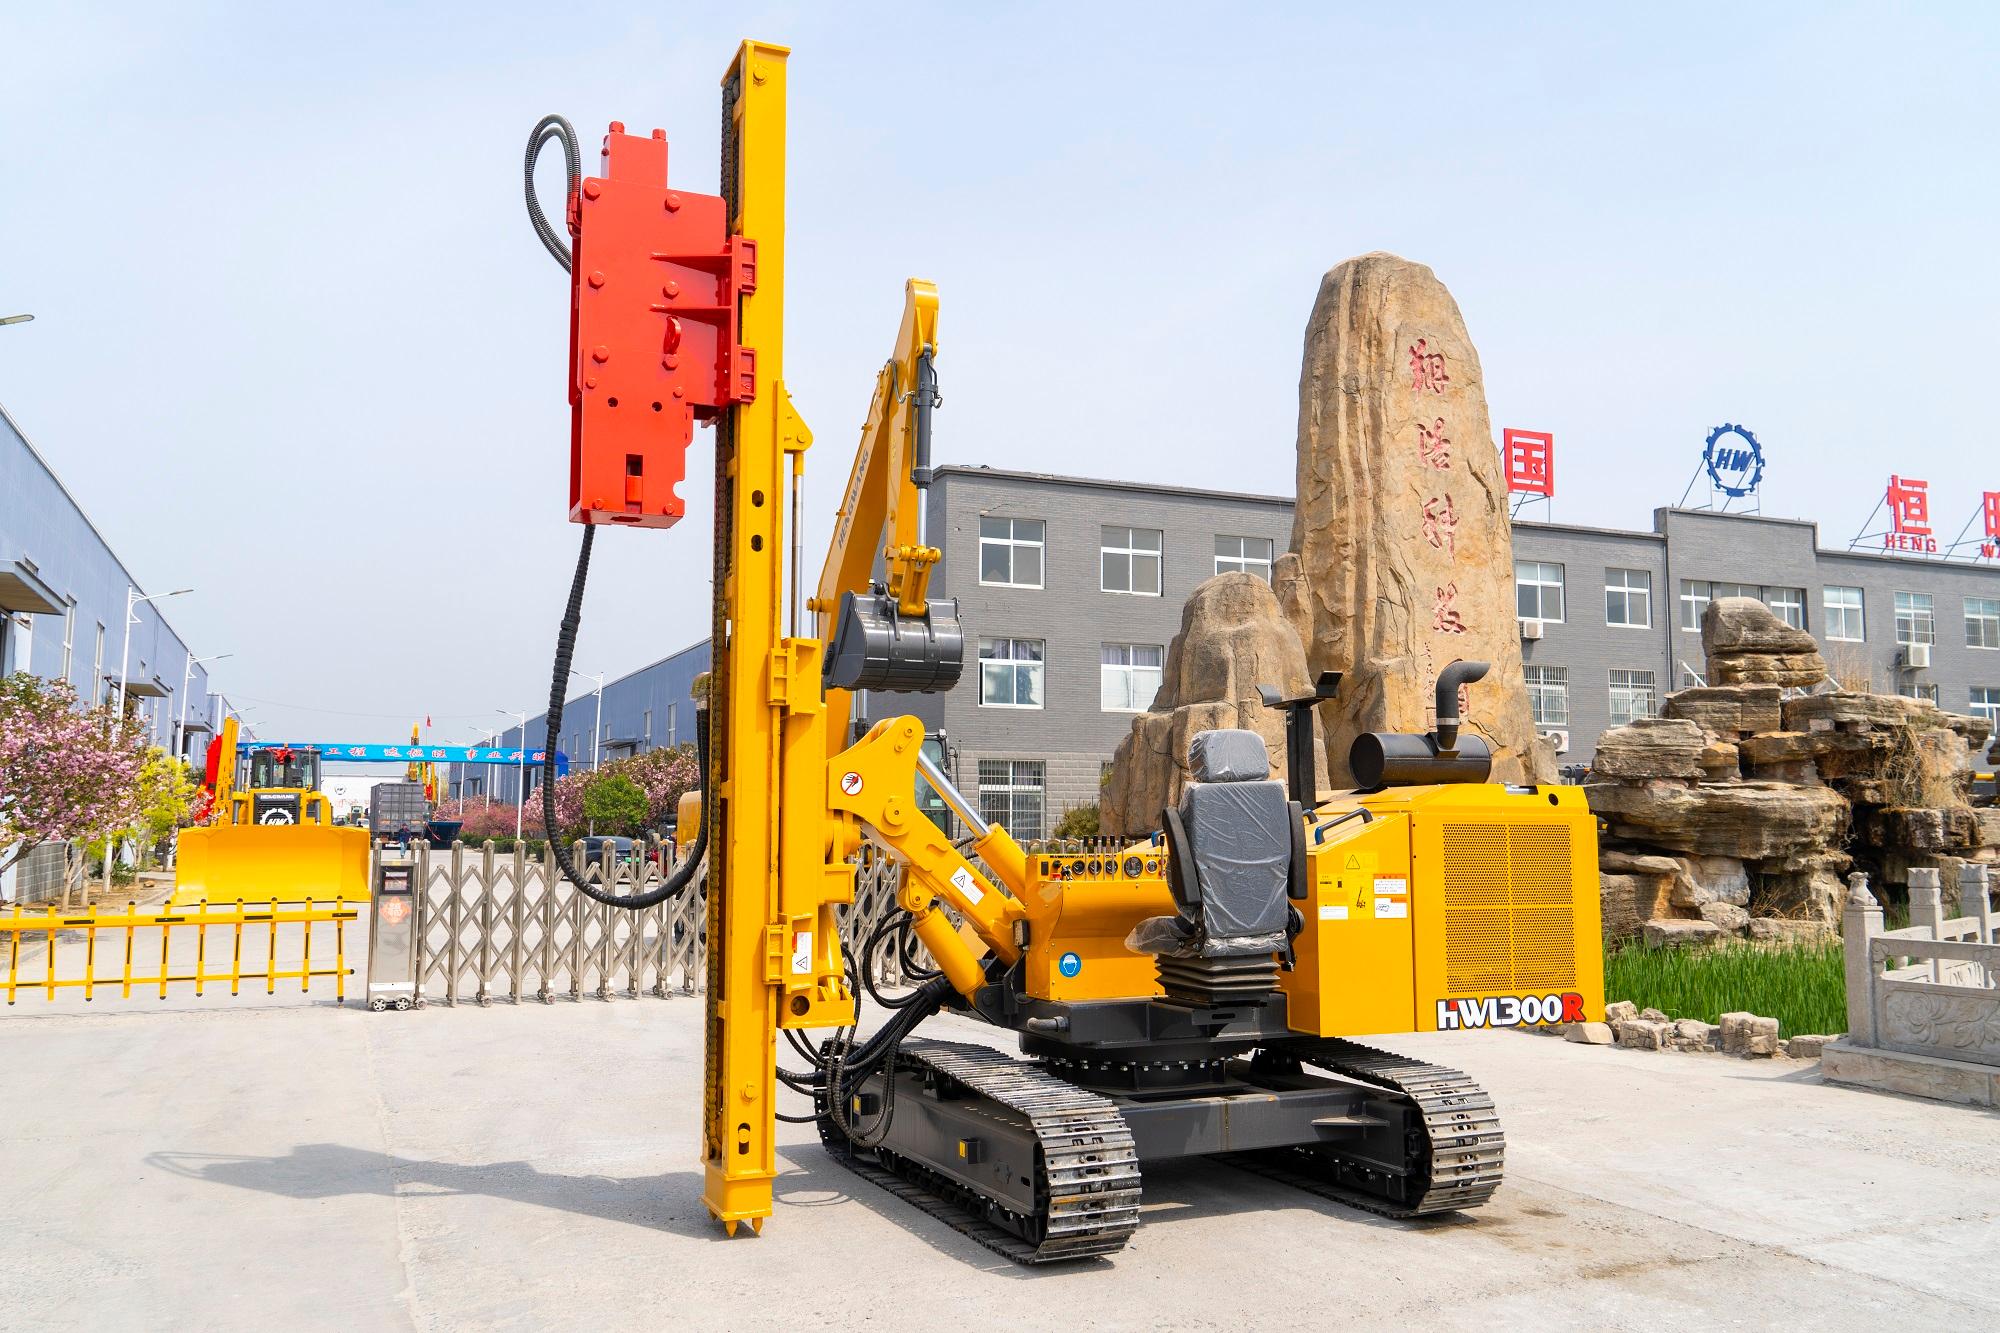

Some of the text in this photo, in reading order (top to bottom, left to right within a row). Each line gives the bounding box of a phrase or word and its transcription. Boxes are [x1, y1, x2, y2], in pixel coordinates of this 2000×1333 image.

[1503, 428, 1554, 497] 国
[1715, 448, 1754, 472] HW
[838, 448, 870, 549] HENGWANG
[1885, 533, 1937, 553] HENG
[1436, 993, 1587, 1031] HWL300R
